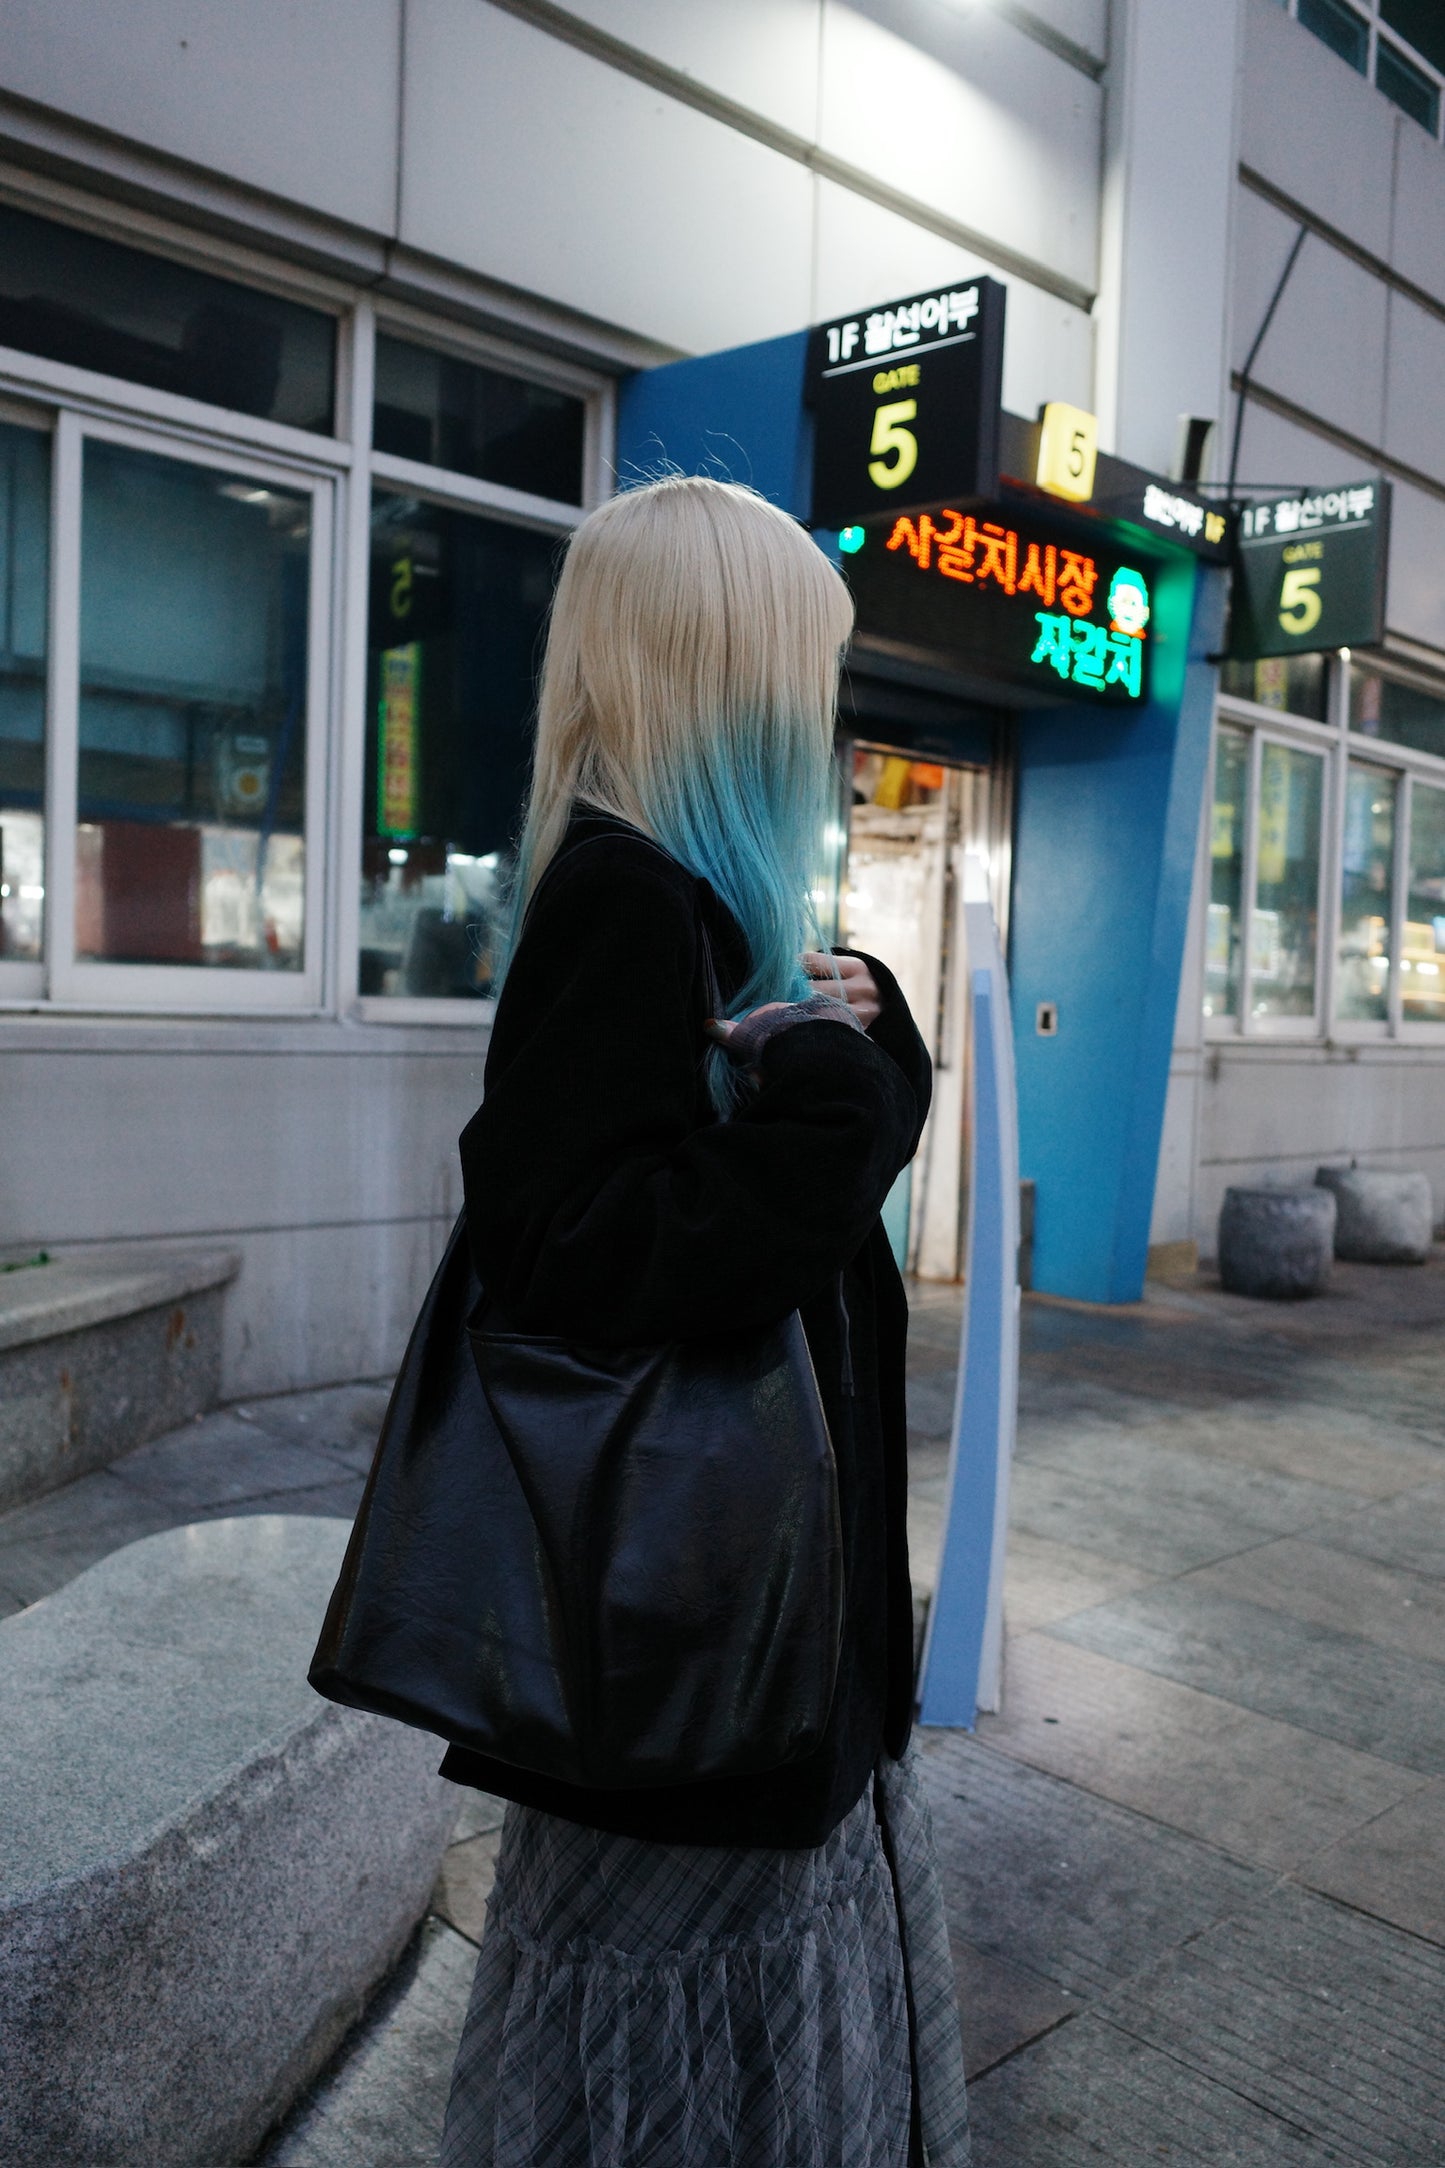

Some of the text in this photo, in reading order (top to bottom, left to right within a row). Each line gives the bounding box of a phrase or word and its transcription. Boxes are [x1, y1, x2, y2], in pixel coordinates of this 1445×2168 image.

[827, 321, 860, 363] 1F
[872, 363, 921, 394] GATE
[868, 398, 918, 489] 5
[1067, 430, 1086, 478] 5
[1242, 506, 1271, 537] 1F
[1282, 541, 1324, 564] GATE
[1278, 567, 1322, 635] 5
[1030, 611, 1143, 698] 자갈치
